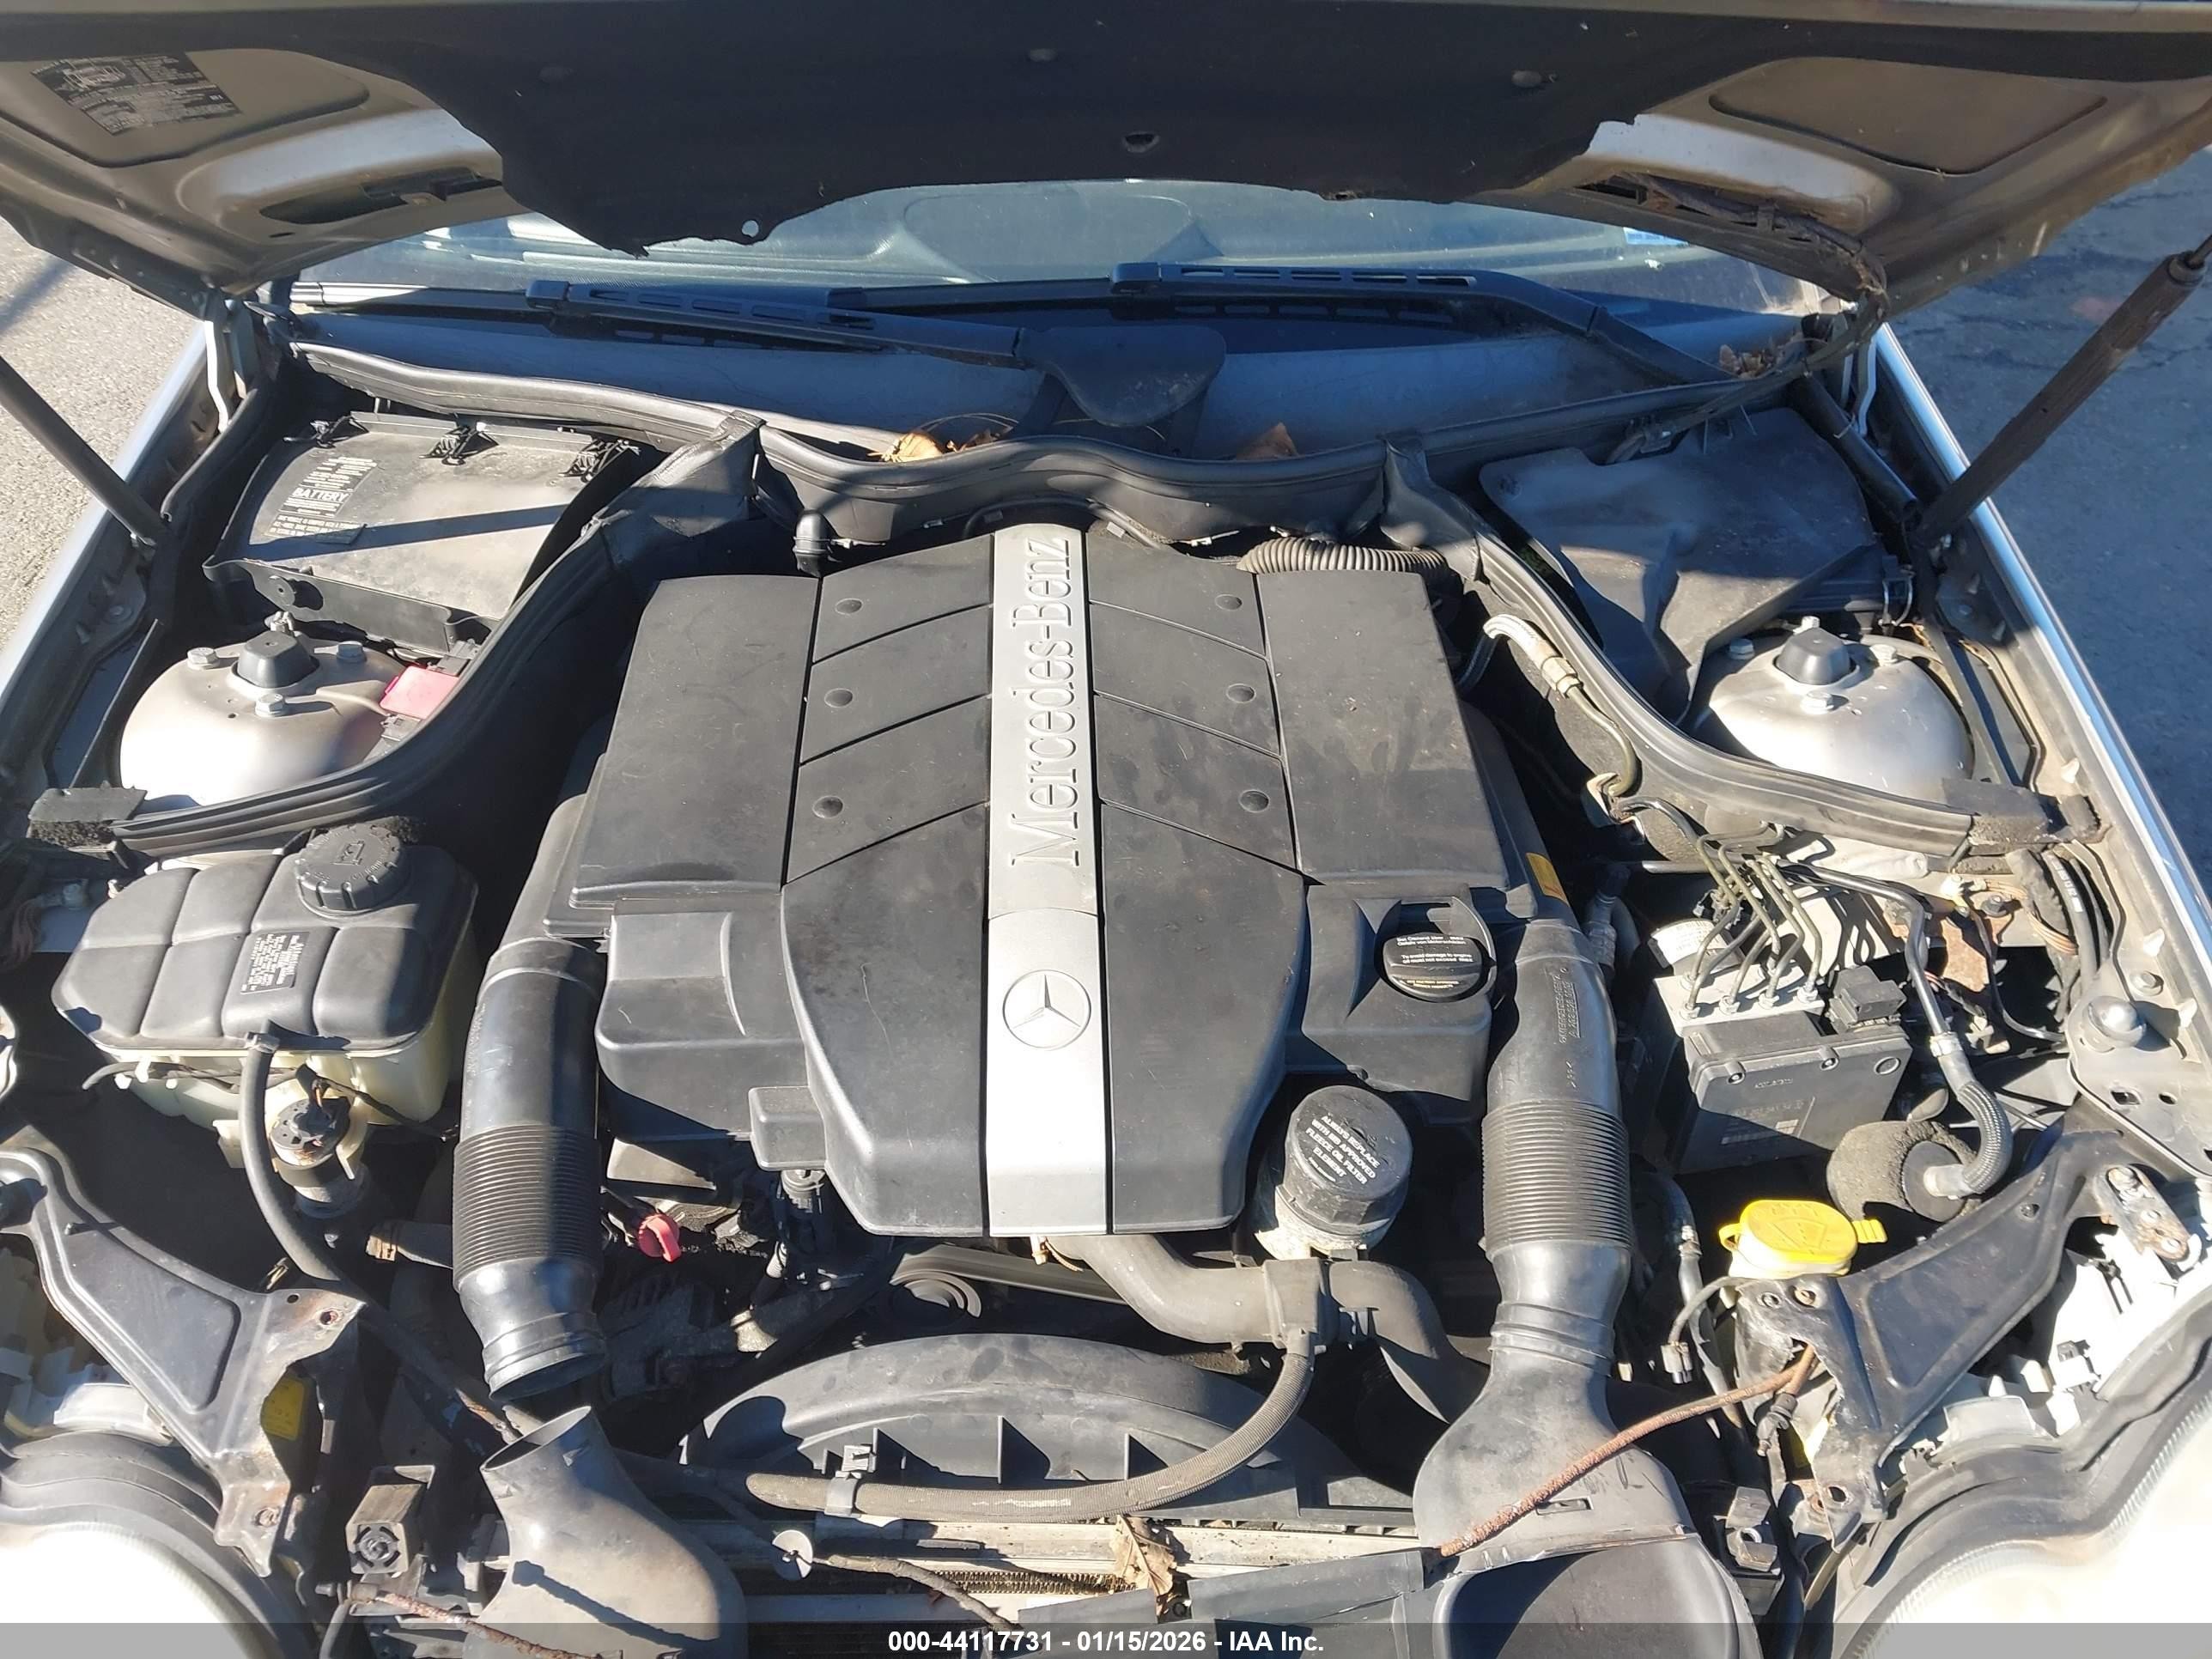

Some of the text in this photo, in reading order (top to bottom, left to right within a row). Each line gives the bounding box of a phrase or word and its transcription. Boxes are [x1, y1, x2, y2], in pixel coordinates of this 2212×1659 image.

[292, 487, 349, 502] BATTERY
[1010, 539, 1079, 867] Mercedes-Benz
[1305, 1127, 1334, 1152] FLEECE
[1331, 1150, 1344, 1164] OIL
[1343, 1159, 1368, 1185] FILTER
[1311, 1119, 1330, 1136] WITH
[1340, 1143, 1376, 1179] APPROVED
[1312, 1146, 1346, 1177] ELEMENT
[1321, 1115, 1381, 1169] ALWAYS REPLACE
